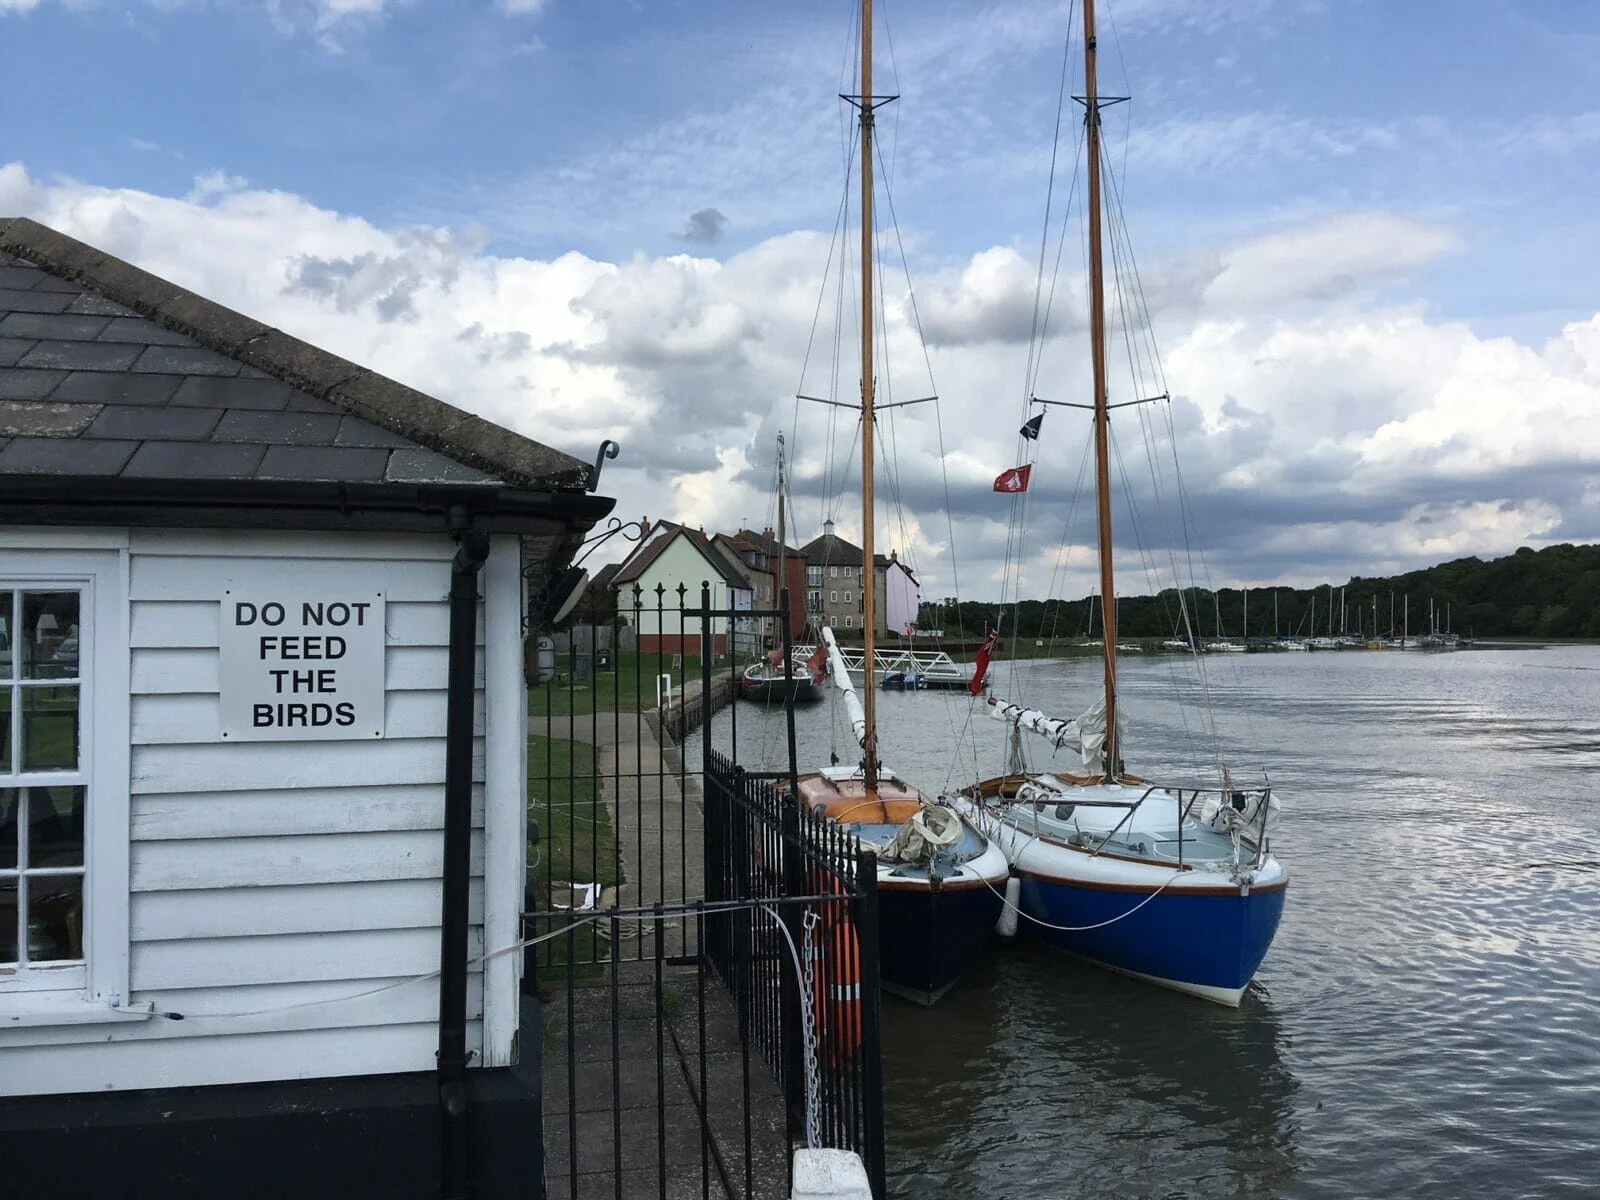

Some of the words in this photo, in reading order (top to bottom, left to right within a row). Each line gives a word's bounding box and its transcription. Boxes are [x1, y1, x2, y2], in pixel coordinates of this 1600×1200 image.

[235, 602, 286, 626] DO
[302, 602, 371, 626] NOT
[260, 636, 347, 660] FEED
[269, 670, 337, 693] THE
[253, 702, 356, 727] BIRDS
